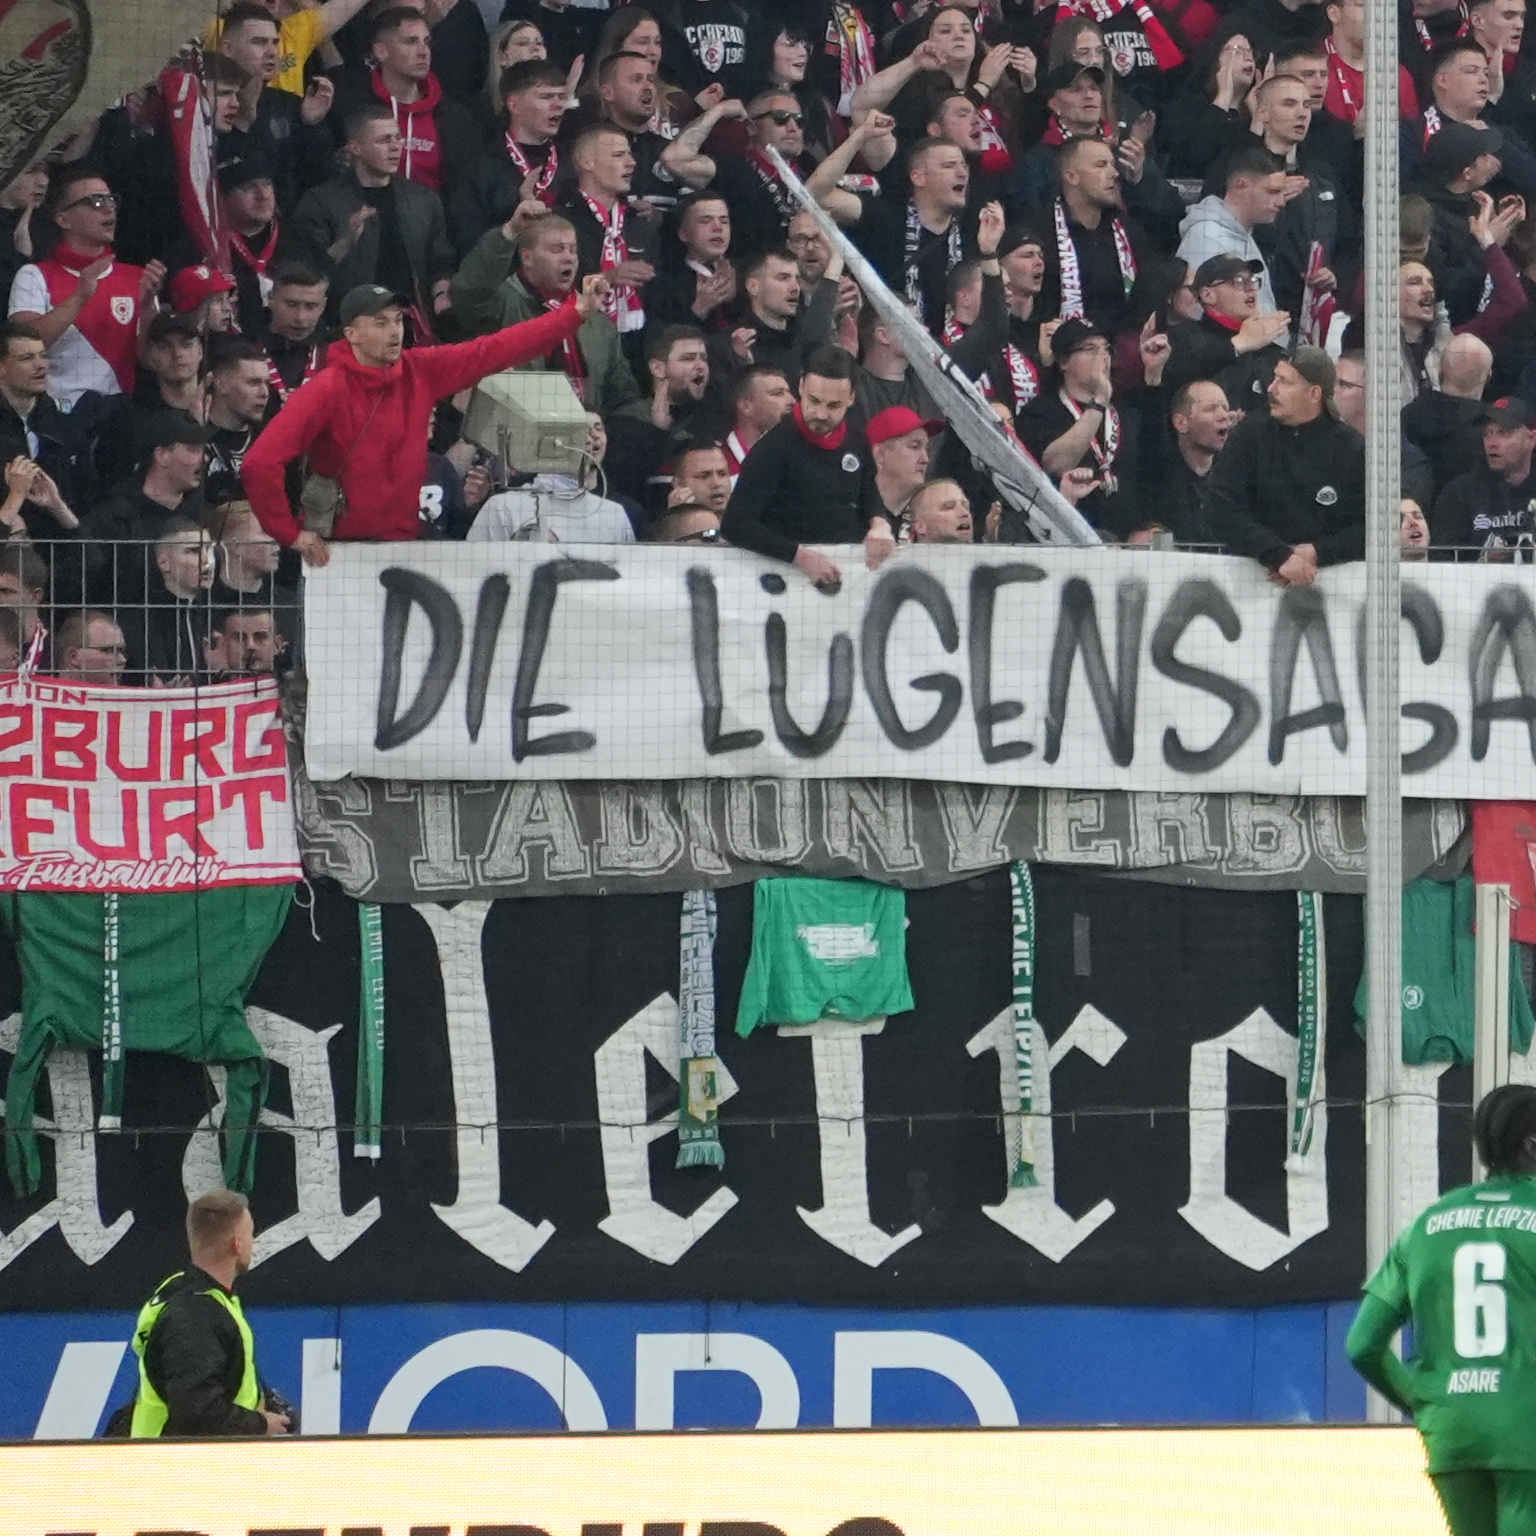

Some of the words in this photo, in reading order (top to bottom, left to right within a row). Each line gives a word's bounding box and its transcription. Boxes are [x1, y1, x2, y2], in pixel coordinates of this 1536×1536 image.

[374, 559, 622, 766] DIE
[0, 774, 287, 862] FURT
[1426, 1205, 1484, 1236] CHEMIE
[1453, 1240, 1508, 1358] 6
[1447, 1368, 1500, 1394] ASARE
